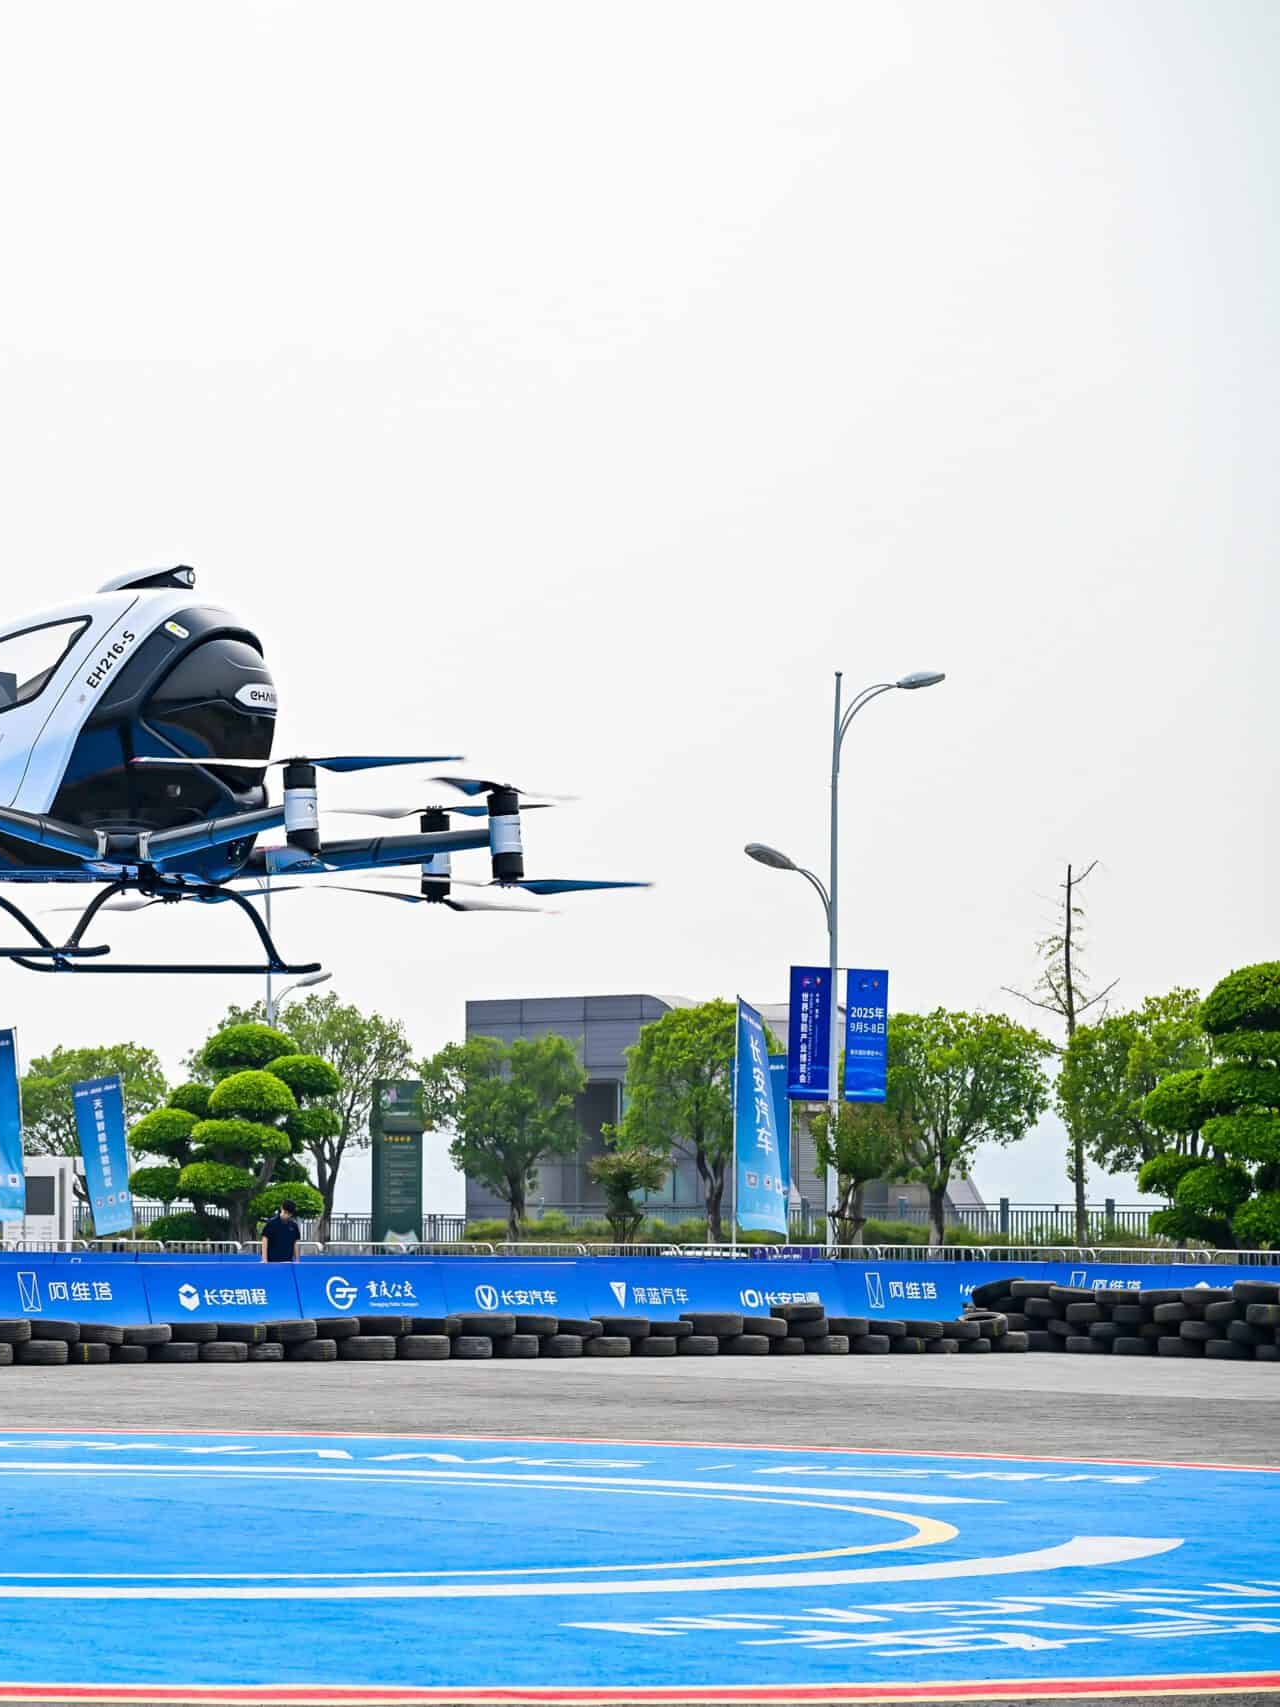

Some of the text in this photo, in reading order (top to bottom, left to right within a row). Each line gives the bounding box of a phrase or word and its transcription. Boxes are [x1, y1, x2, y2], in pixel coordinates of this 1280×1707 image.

[86, 630, 136, 689] EH216-S
[850, 1006, 885, 1020] 2025年
[850, 1022, 885, 1034] 9月5-8日
[750, 1035, 774, 1156] 长安汽车
[48, 1281, 113, 1302] 阿维塔
[203, 1288, 268, 1306] 长安凯程
[365, 1280, 417, 1299] 重庆公交
[501, 1289, 559, 1306] 长安汽车
[631, 1287, 689, 1305] 深蓝汽车
[889, 1280, 938, 1301] 阿维塔
